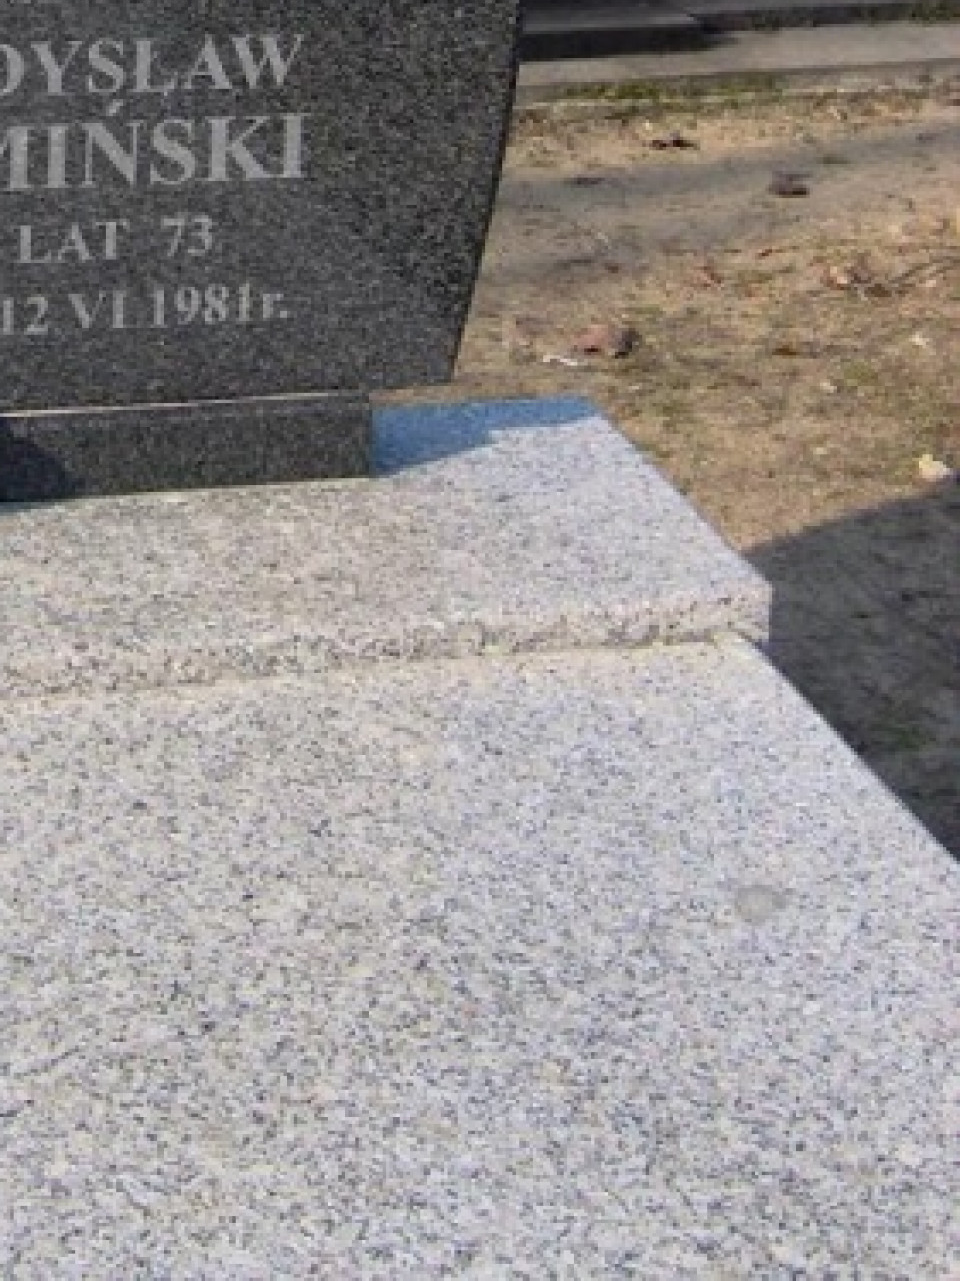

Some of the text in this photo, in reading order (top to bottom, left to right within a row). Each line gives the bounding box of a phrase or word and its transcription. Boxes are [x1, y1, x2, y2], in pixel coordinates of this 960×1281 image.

[19, 221, 128, 265] LAT
[163, 215, 214, 257] 73
[68, 291, 126, 329] VI
